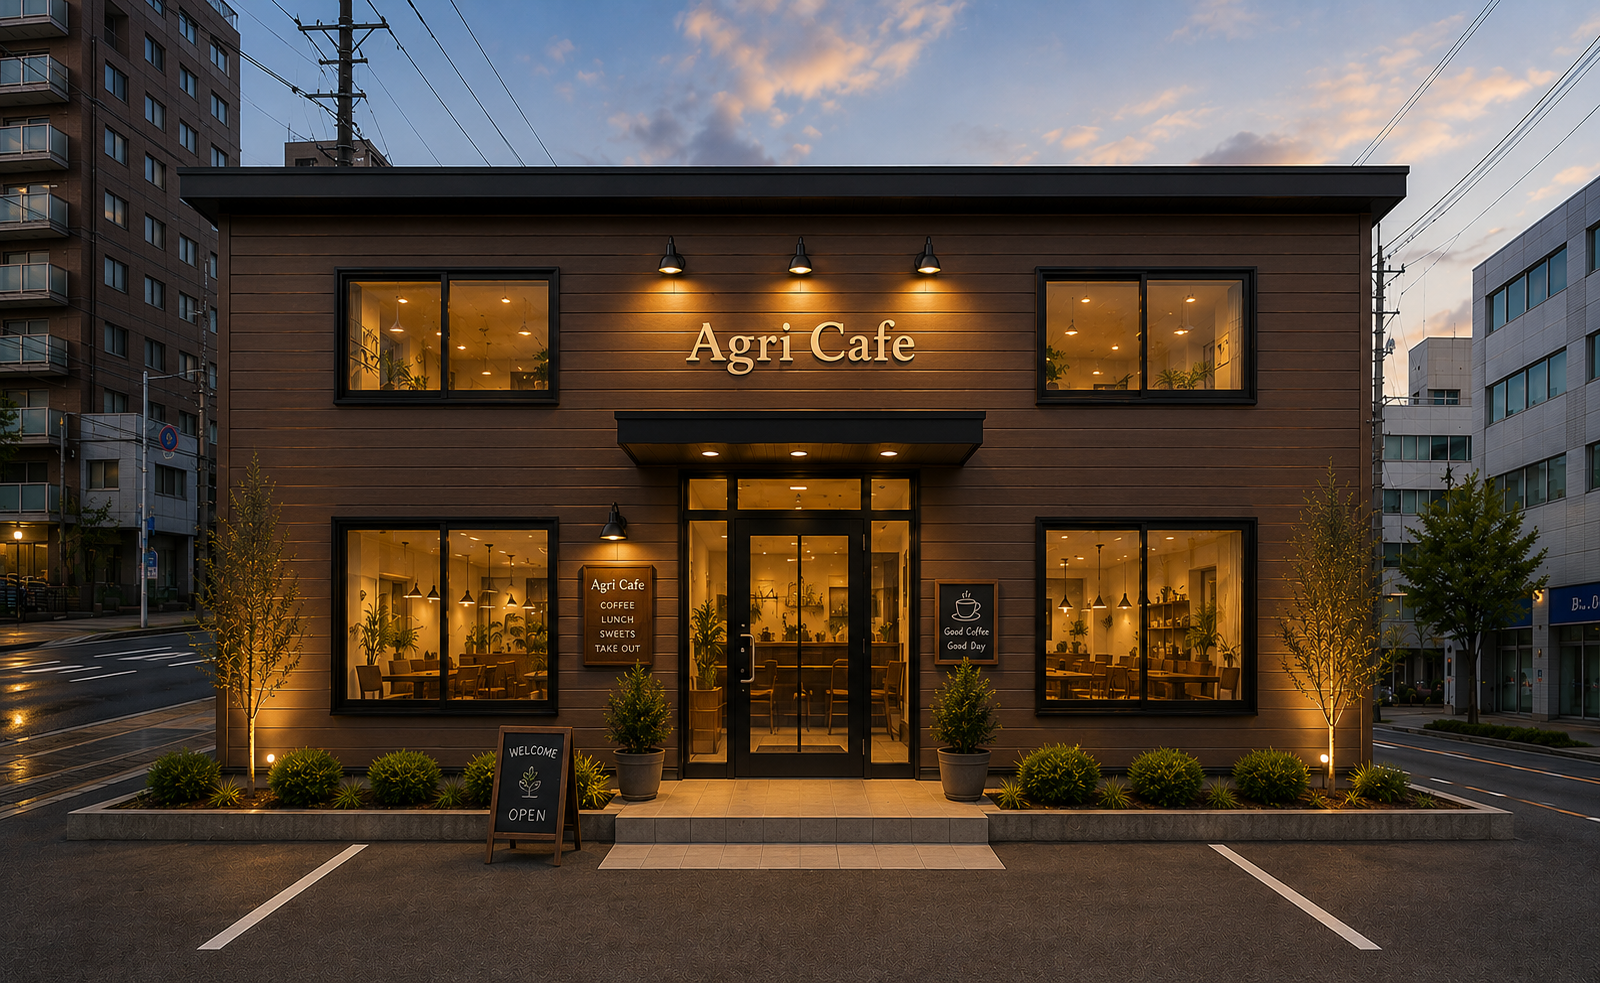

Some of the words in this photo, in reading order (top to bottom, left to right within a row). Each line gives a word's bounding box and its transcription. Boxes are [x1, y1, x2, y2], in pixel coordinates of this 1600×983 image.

[685, 321, 794, 376] Agri
[810, 319, 916, 362] Cafe
[590, 578, 616, 594] Agri
[619, 578, 645, 591] Cafe
[600, 601, 635, 610] COFFEE
[601, 615, 634, 624] LUNCH
[599, 629, 636, 639] SWEETS
[943, 626, 964, 636] Good
[965, 626, 990, 637] Coffee
[594, 644, 618, 653] TAKE
[621, 644, 641, 653] OUT
[947, 640, 968, 651] Good
[970, 640, 986, 653] Day
[508, 745, 559, 759] WELCOME
[508, 808, 546, 822] OPEN
